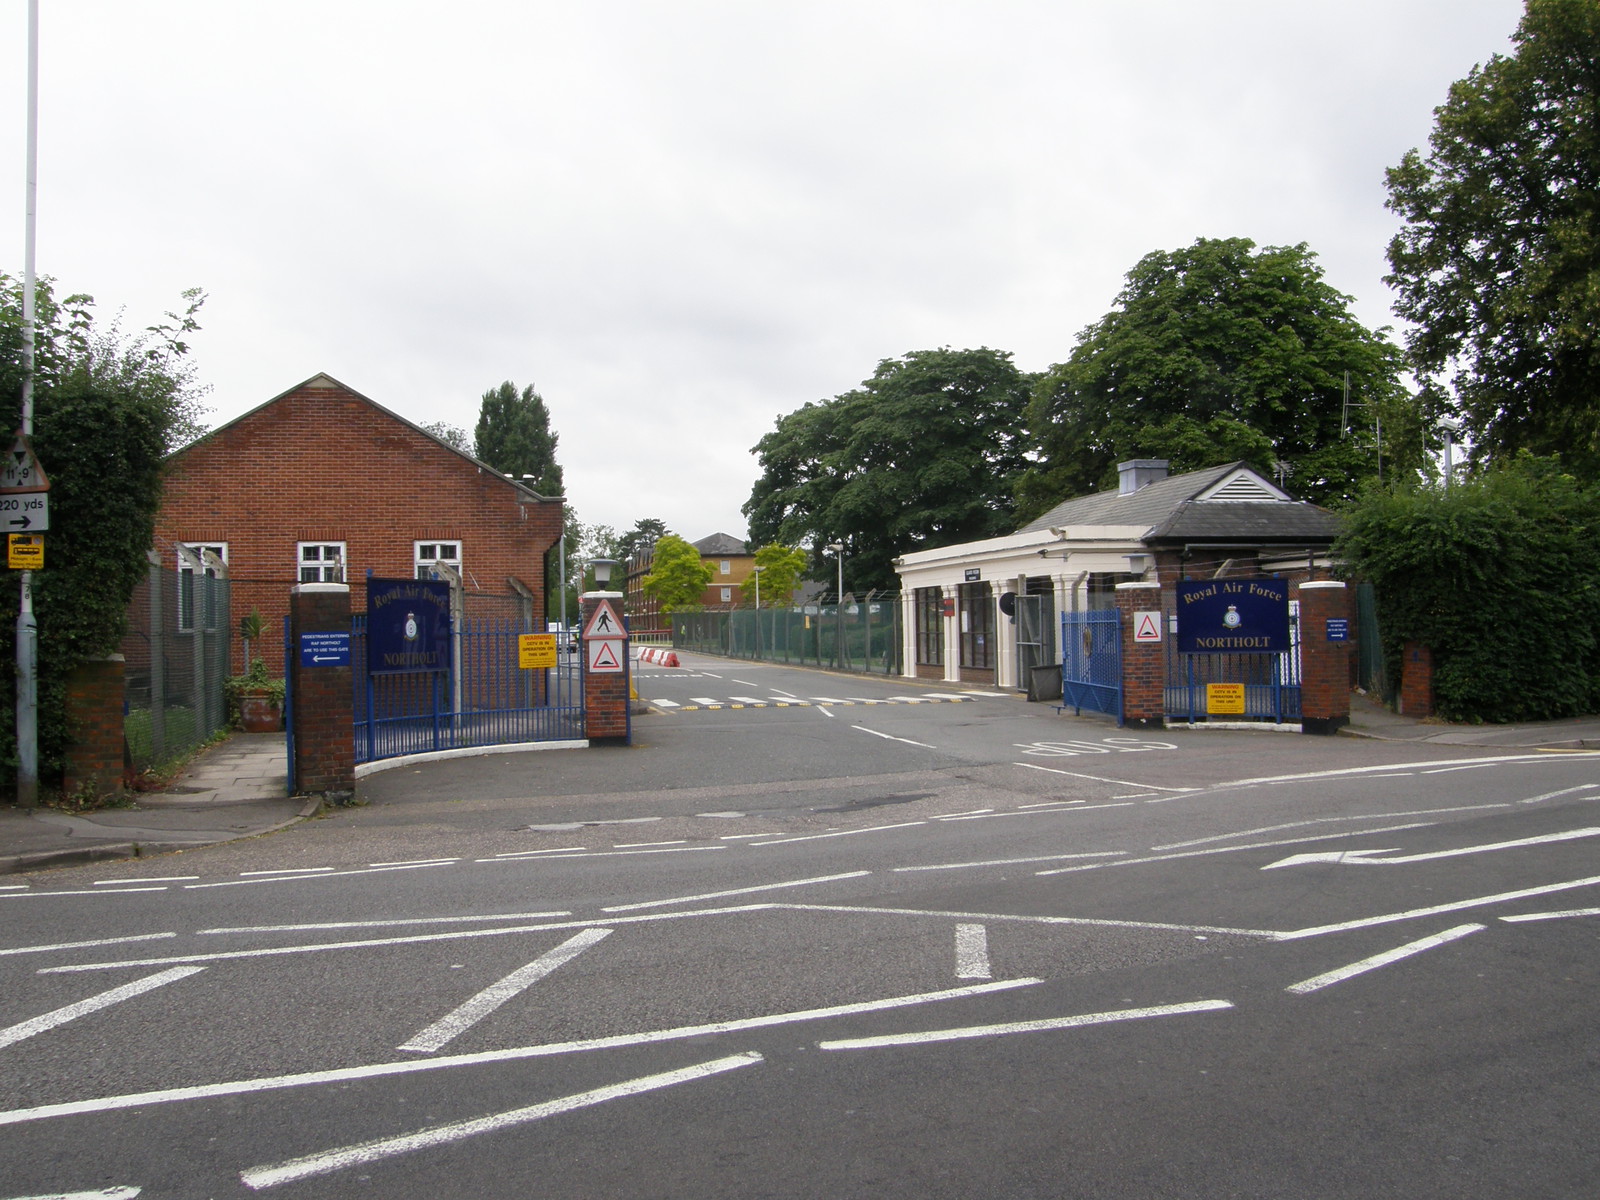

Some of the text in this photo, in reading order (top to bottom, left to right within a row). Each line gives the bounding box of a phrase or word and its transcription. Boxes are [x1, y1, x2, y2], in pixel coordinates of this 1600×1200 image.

[24, 498, 44, 511] yds
[374, 584, 446, 608] Royal Air Force
[1183, 582, 1282, 604] Royal Air Force
[1196, 636, 1271, 648] NORTHOLT
[384, 651, 438, 666] NORTHOLT
[1012, 737, 1178, 757] STOP
